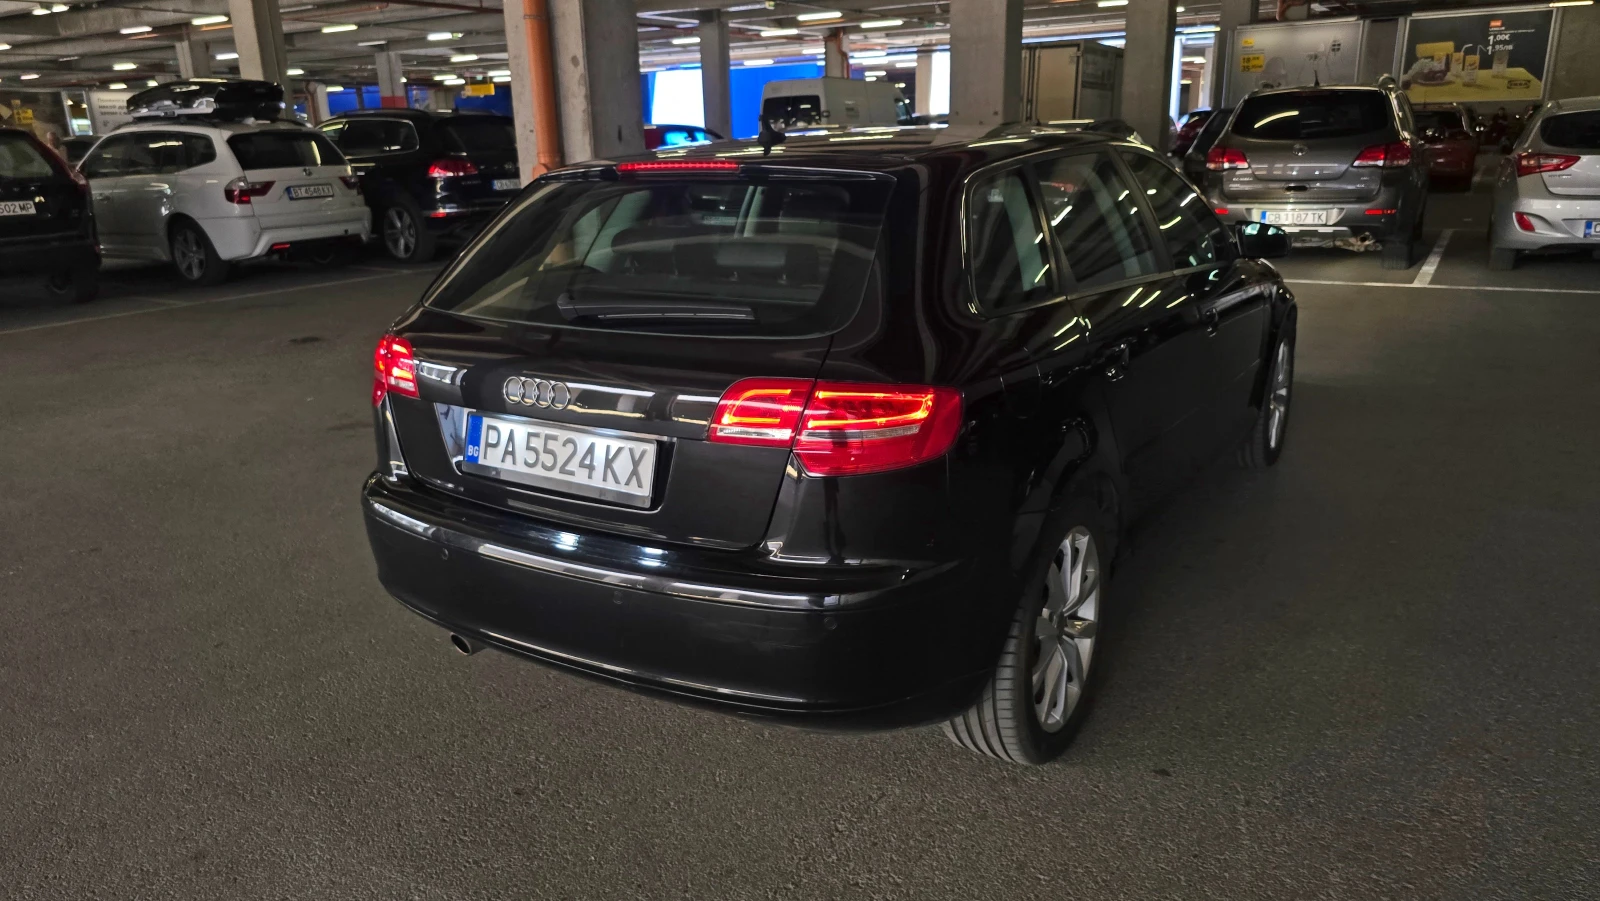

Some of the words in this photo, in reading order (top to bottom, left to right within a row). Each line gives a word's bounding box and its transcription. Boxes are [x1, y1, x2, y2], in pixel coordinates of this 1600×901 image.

[1488, 34, 1510, 45] 1.00€
[18, 203, 33, 212] MP
[1268, 213, 1281, 223] CB
[1311, 213, 1324, 222] TK
[467, 445, 479, 456] BG
